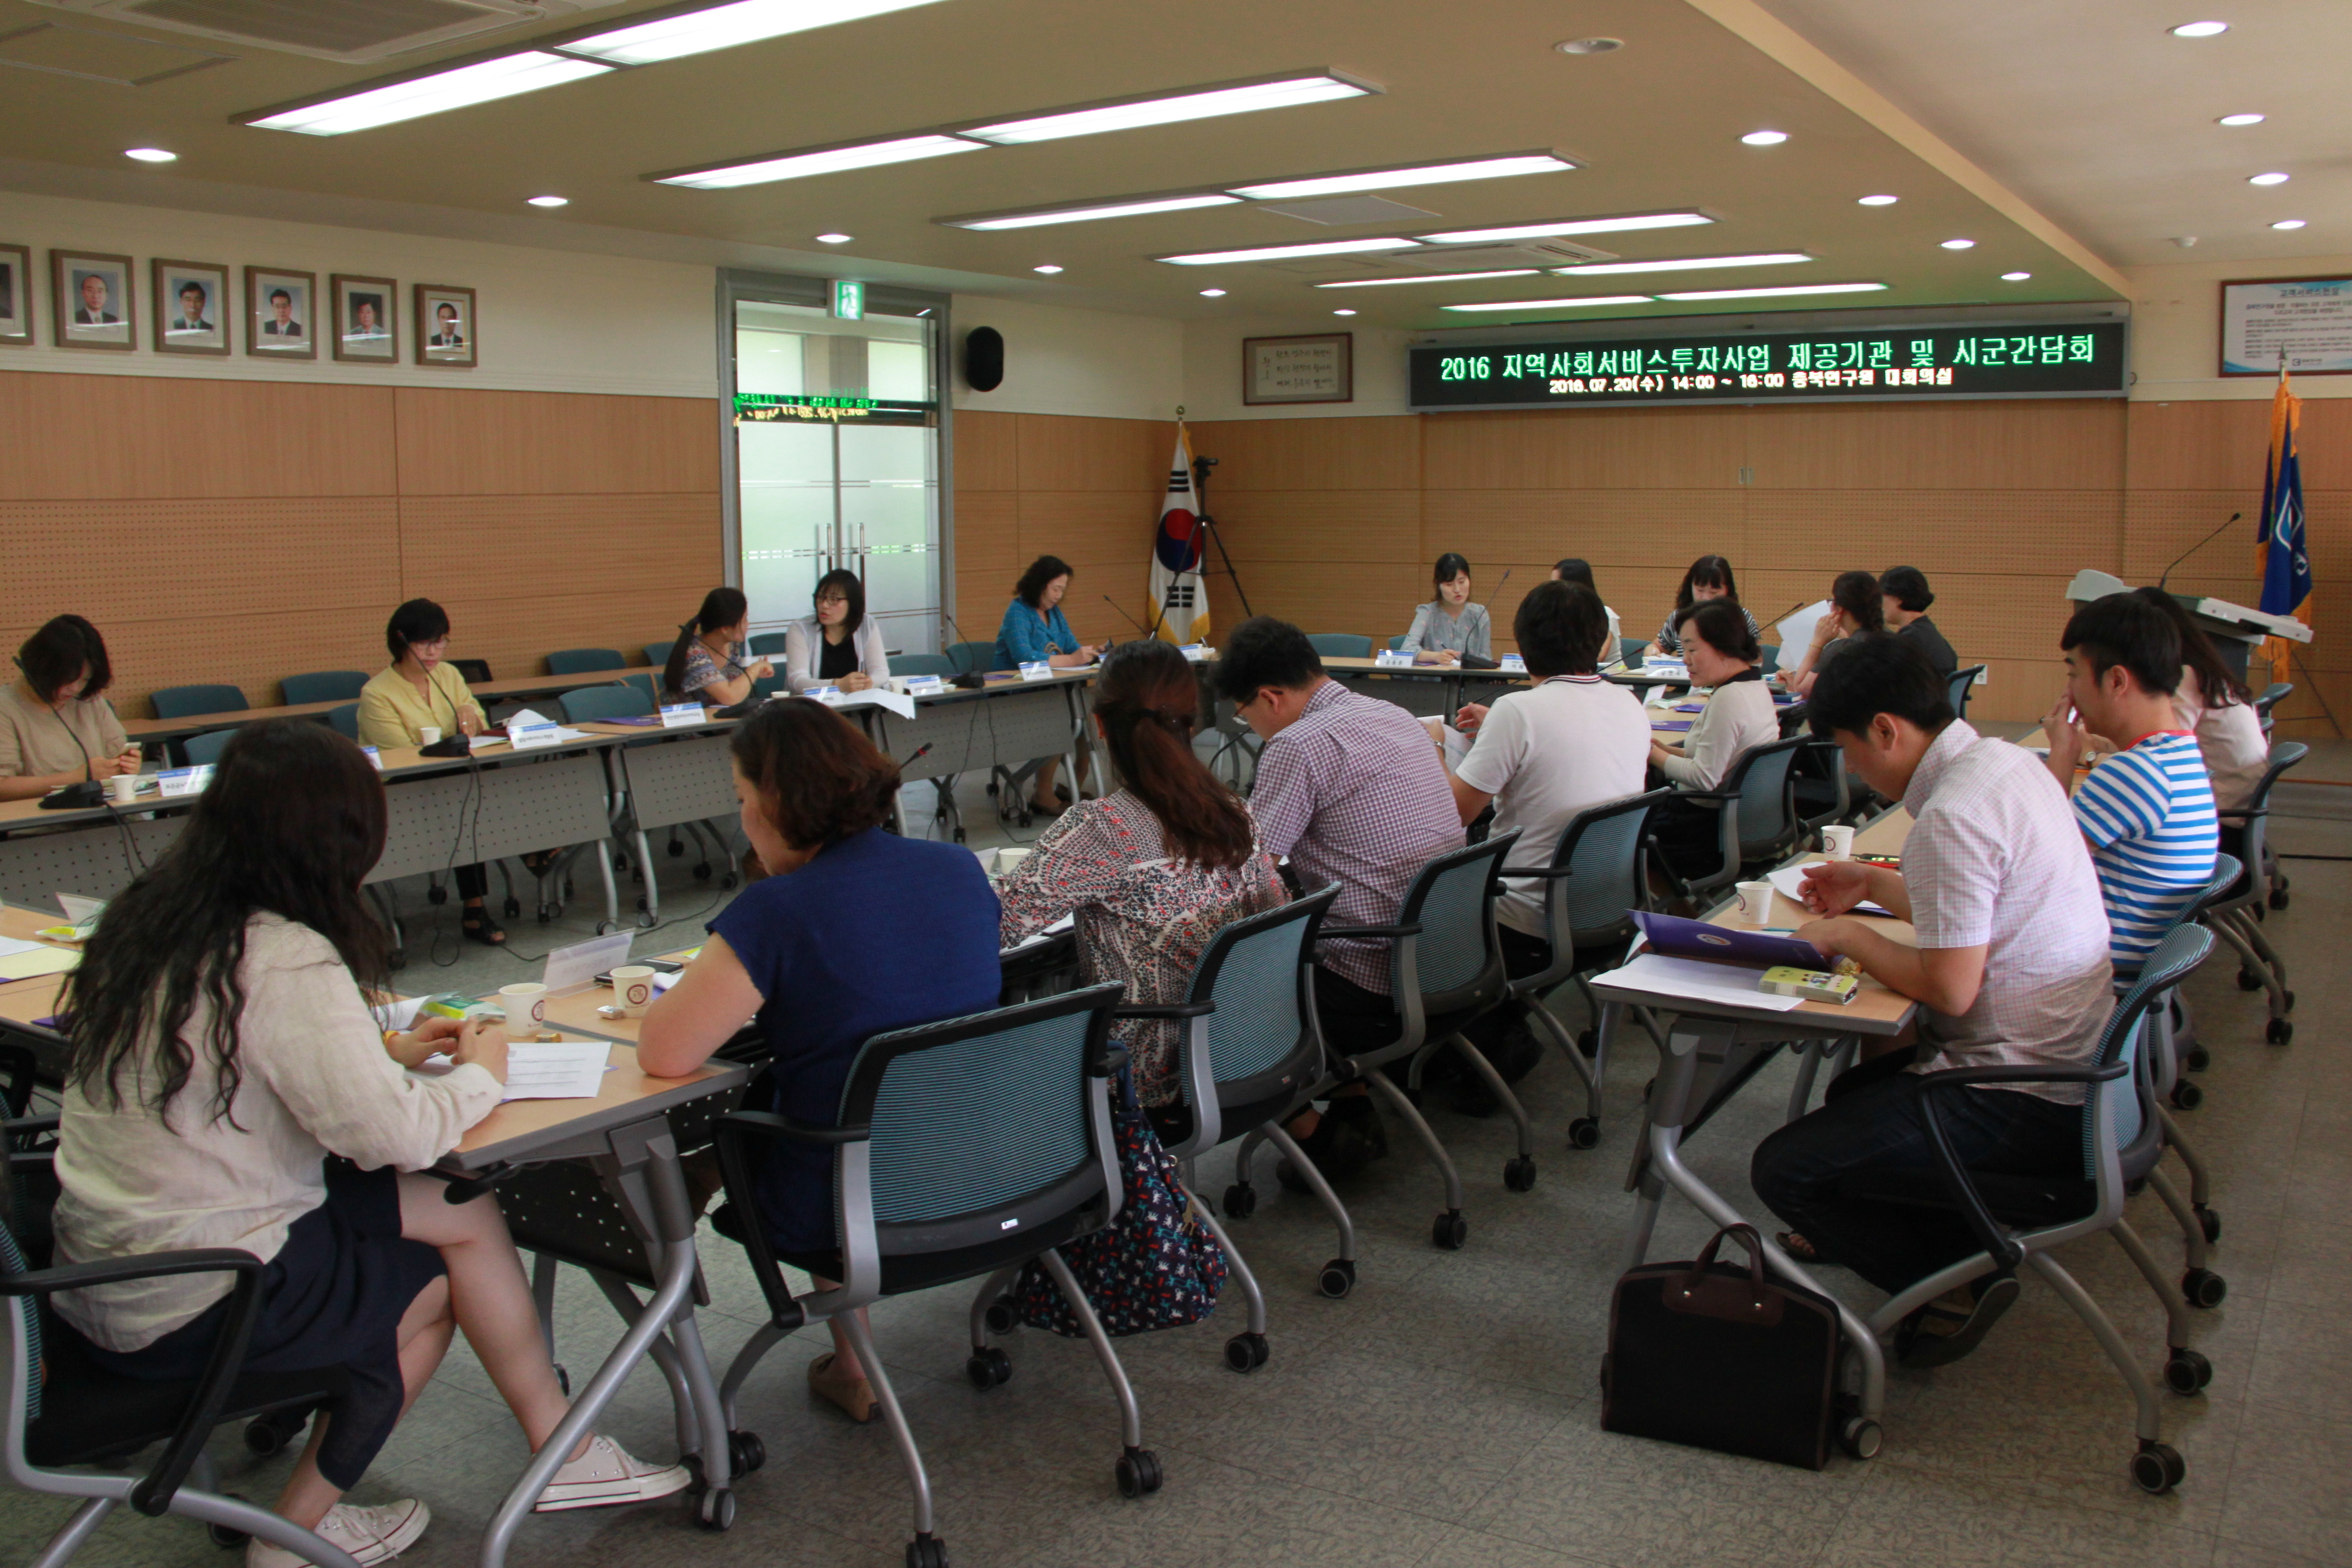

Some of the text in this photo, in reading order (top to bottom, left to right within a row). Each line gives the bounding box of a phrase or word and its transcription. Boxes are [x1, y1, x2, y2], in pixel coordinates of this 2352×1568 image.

[1440, 334, 2094, 381] 2016 지역사회서비스투자사업 제공기관 및 시군간담회
[1549, 374, 1664, 394] 2016.07.20(수)
[1670, 375, 1715, 391] 14:00
[1739, 372, 1785, 389] 16:00
[1791, 368, 1874, 389] 충북연구원
[1884, 367, 1953, 387] 대회의실
